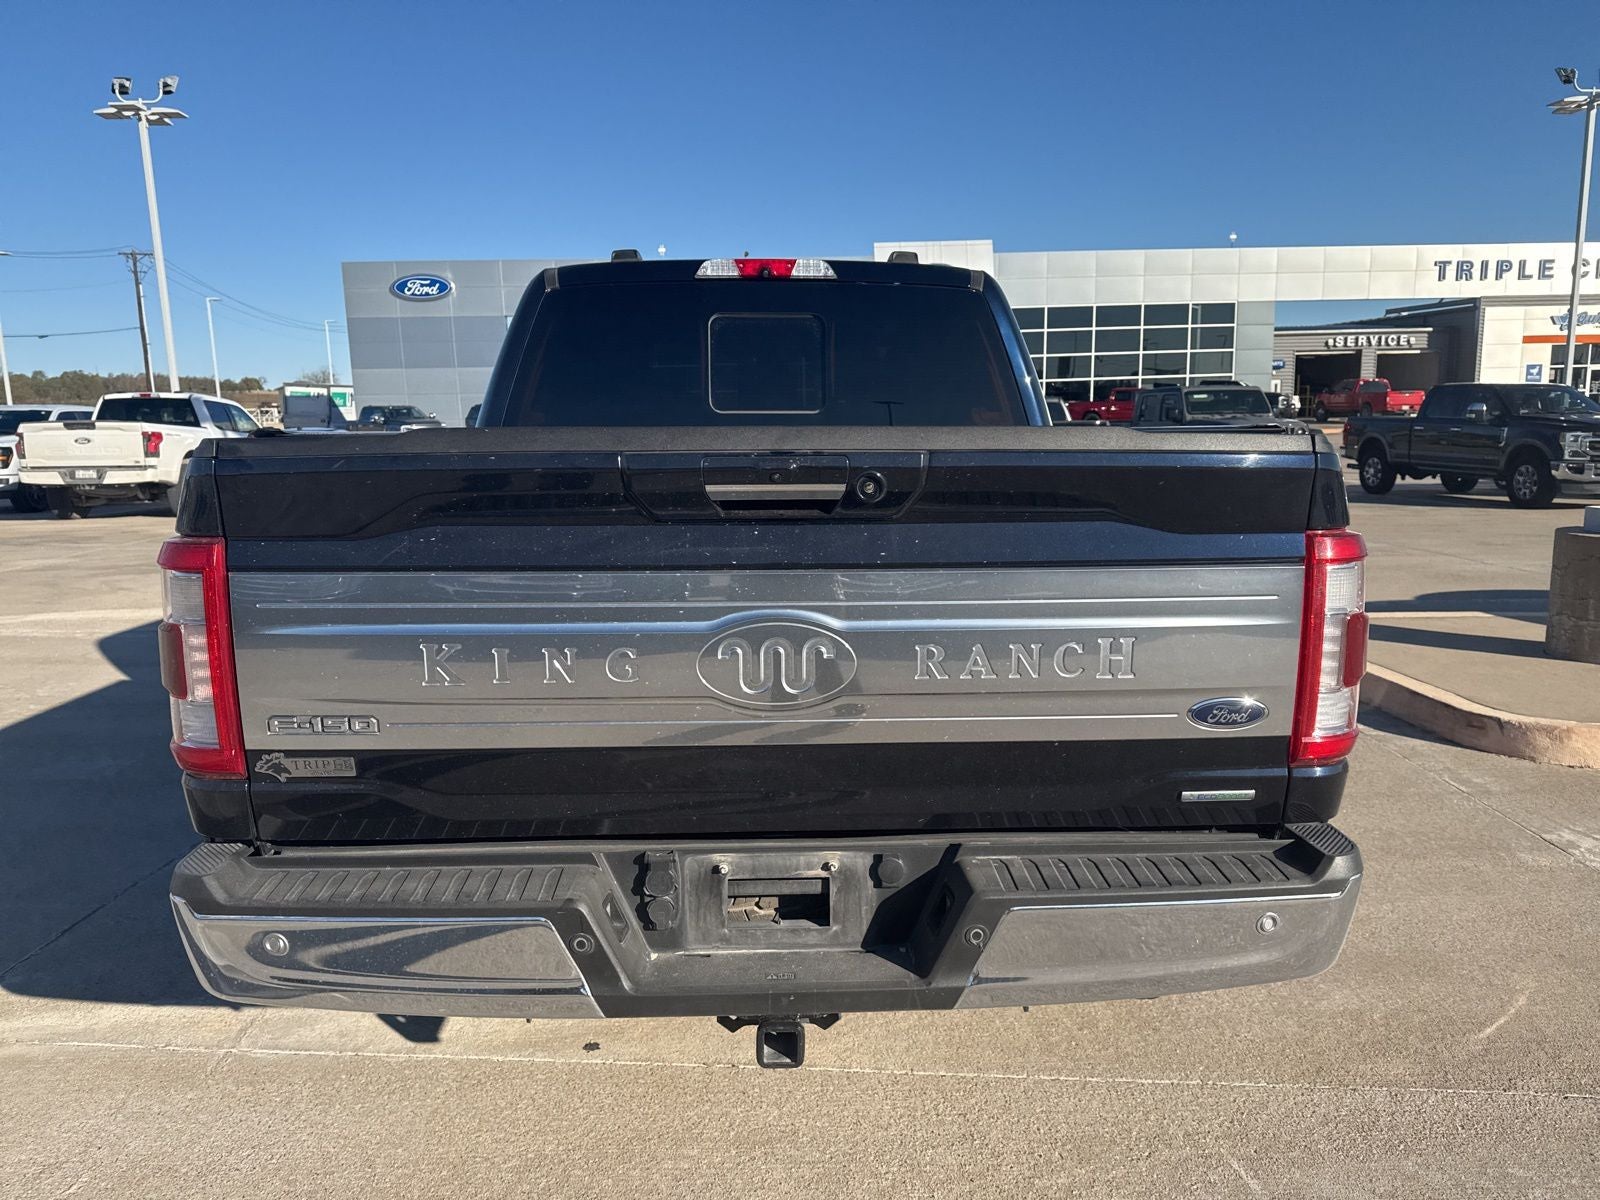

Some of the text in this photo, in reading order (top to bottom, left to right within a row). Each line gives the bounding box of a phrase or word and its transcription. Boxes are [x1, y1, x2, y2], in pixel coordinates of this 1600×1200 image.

[1434, 258, 1600, 281] TRIPLE C
[404, 279, 440, 295] Ford
[1335, 334, 1409, 347] SERVICE
[419, 636, 1137, 686] KING RANCH
[1207, 704, 1252, 723] Ford
[267, 715, 380, 734] F-150
